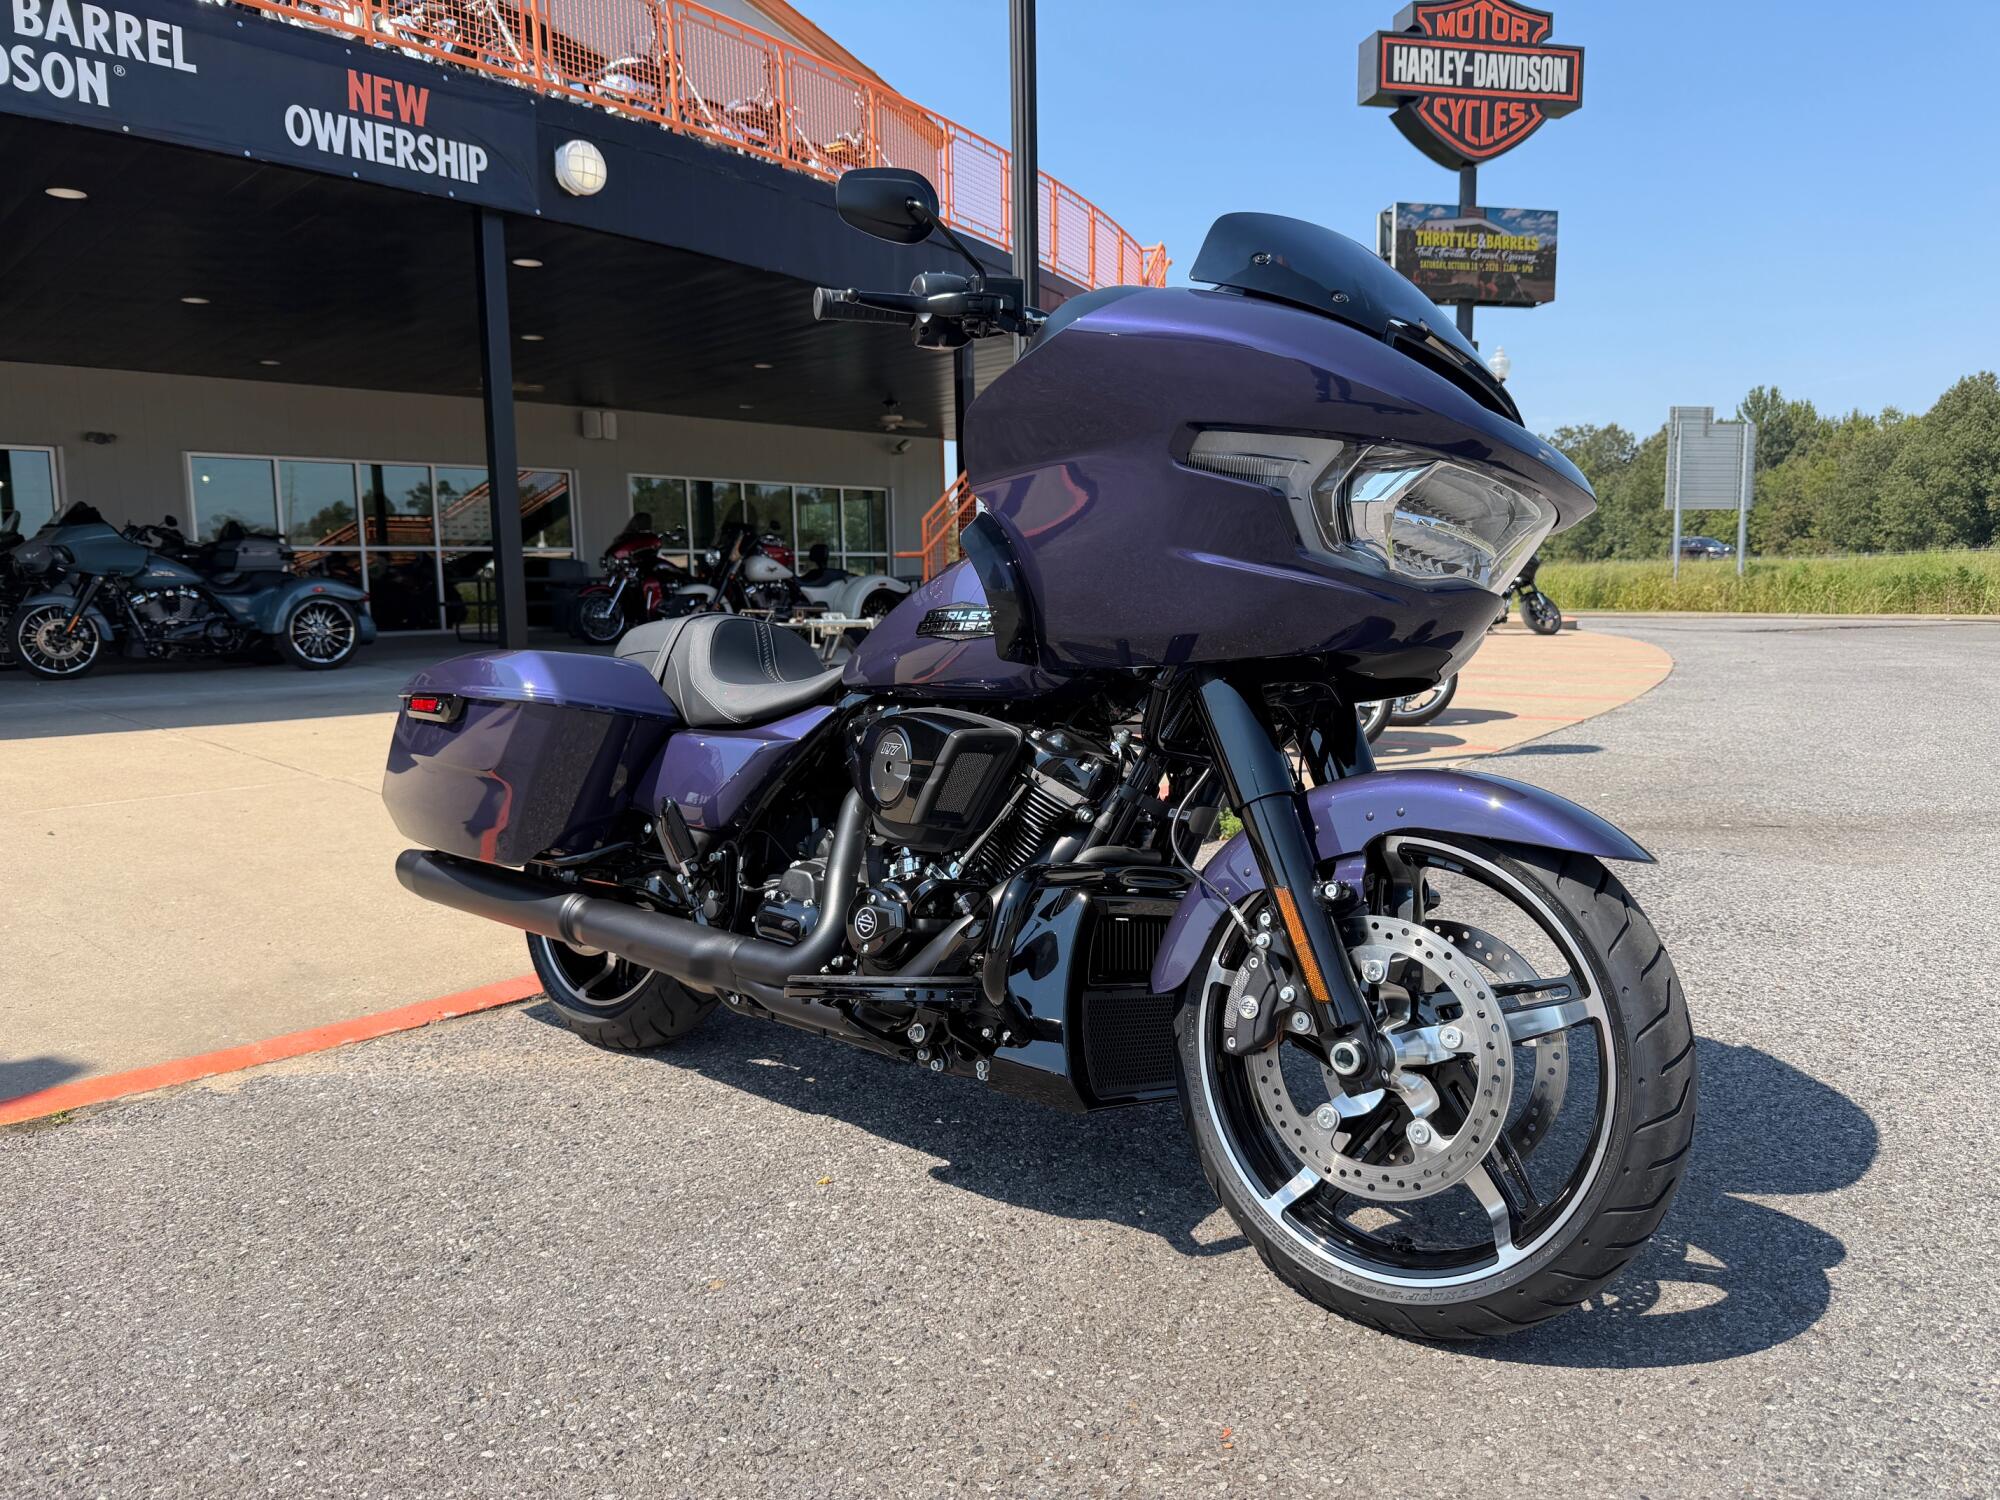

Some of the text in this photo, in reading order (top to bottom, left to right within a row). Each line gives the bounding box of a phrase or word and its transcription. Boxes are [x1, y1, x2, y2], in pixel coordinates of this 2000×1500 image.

[12, 0, 198, 74] BARREL
[1436, 1, 1529, 44] MOTOR
[1392, 45, 1569, 93] HARLEY-DAVIDSON
[347, 68, 430, 127] NEW
[1433, 97, 1526, 146] CYCLES
[284, 104, 488, 184] OWNERSHIP
[919, 621, 994, 632] DAVIDSO
[927, 610, 992, 622] HARLEY
[880, 741, 903, 756] 117
